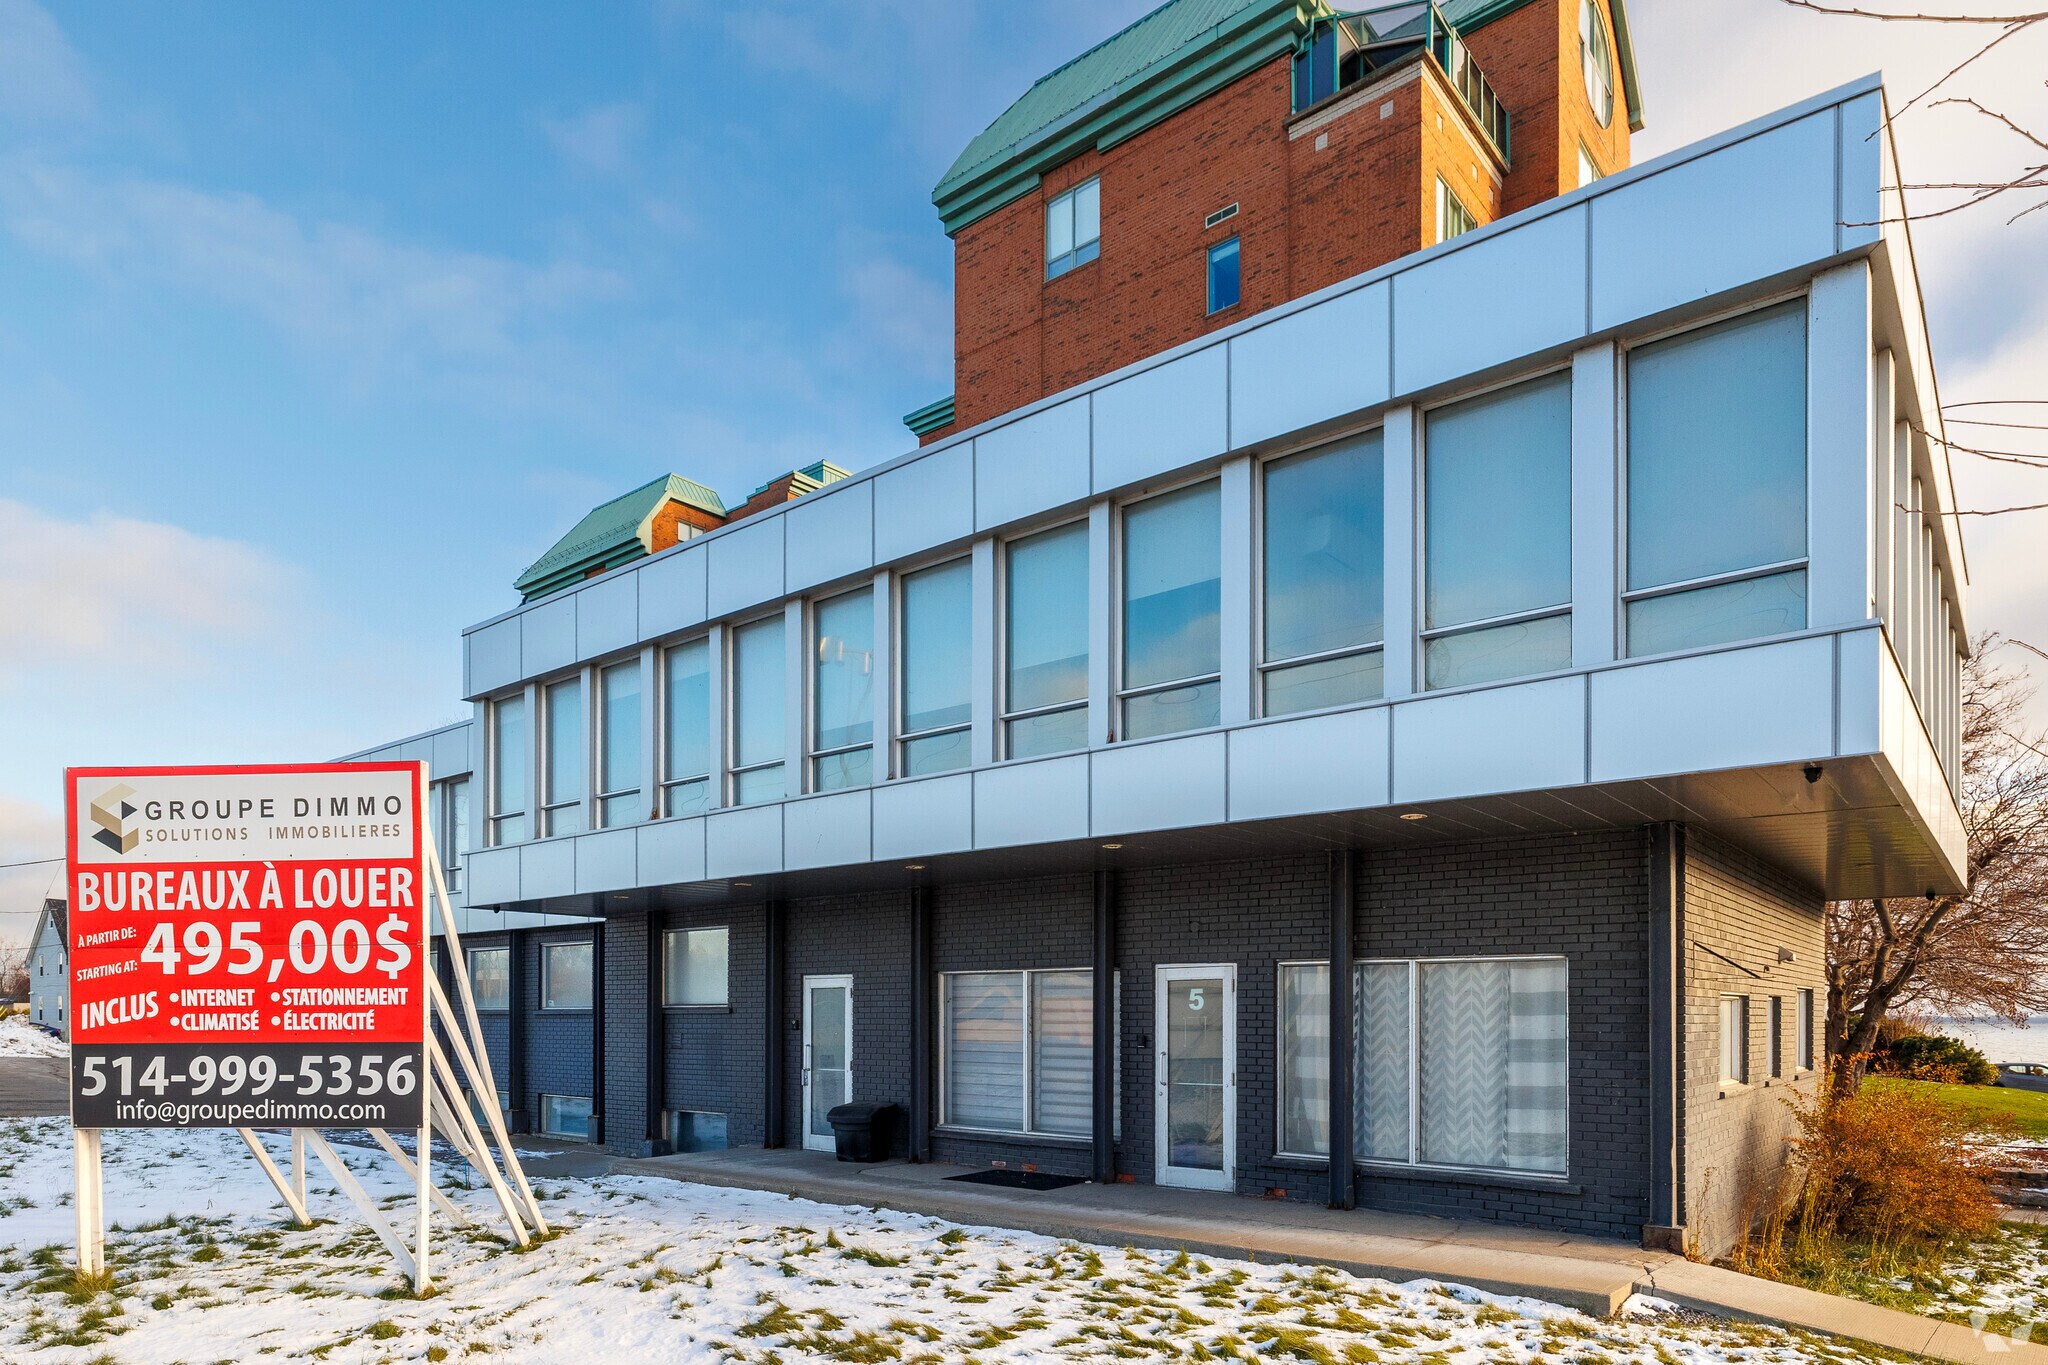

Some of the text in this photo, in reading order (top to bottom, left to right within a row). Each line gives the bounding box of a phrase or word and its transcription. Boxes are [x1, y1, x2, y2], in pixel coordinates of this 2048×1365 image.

[145, 796, 402, 820] GROUPE DIMMO
[146, 824, 400, 842] SOLUTIONS IMMOBILIERES
[78, 862, 413, 912] BUREAUX À LOUER
[78, 927, 136, 948] À PARTIR DE:
[140, 913, 411, 983] 495,00$
[77, 960, 137, 981] STARTING AT:
[181, 989, 255, 1006] INTERNET
[283, 988, 408, 1006] STATIONNEMENT
[1188, 988, 1204, 1011] 5
[82, 991, 159, 1029] INCLUS
[181, 1012, 259, 1030] CLIMATISÉ
[284, 1012, 374, 1030] ÉLECTRICITÉ
[82, 1055, 415, 1096] 514-999-5356
[117, 1099, 385, 1123] info@groupedimmo.com
